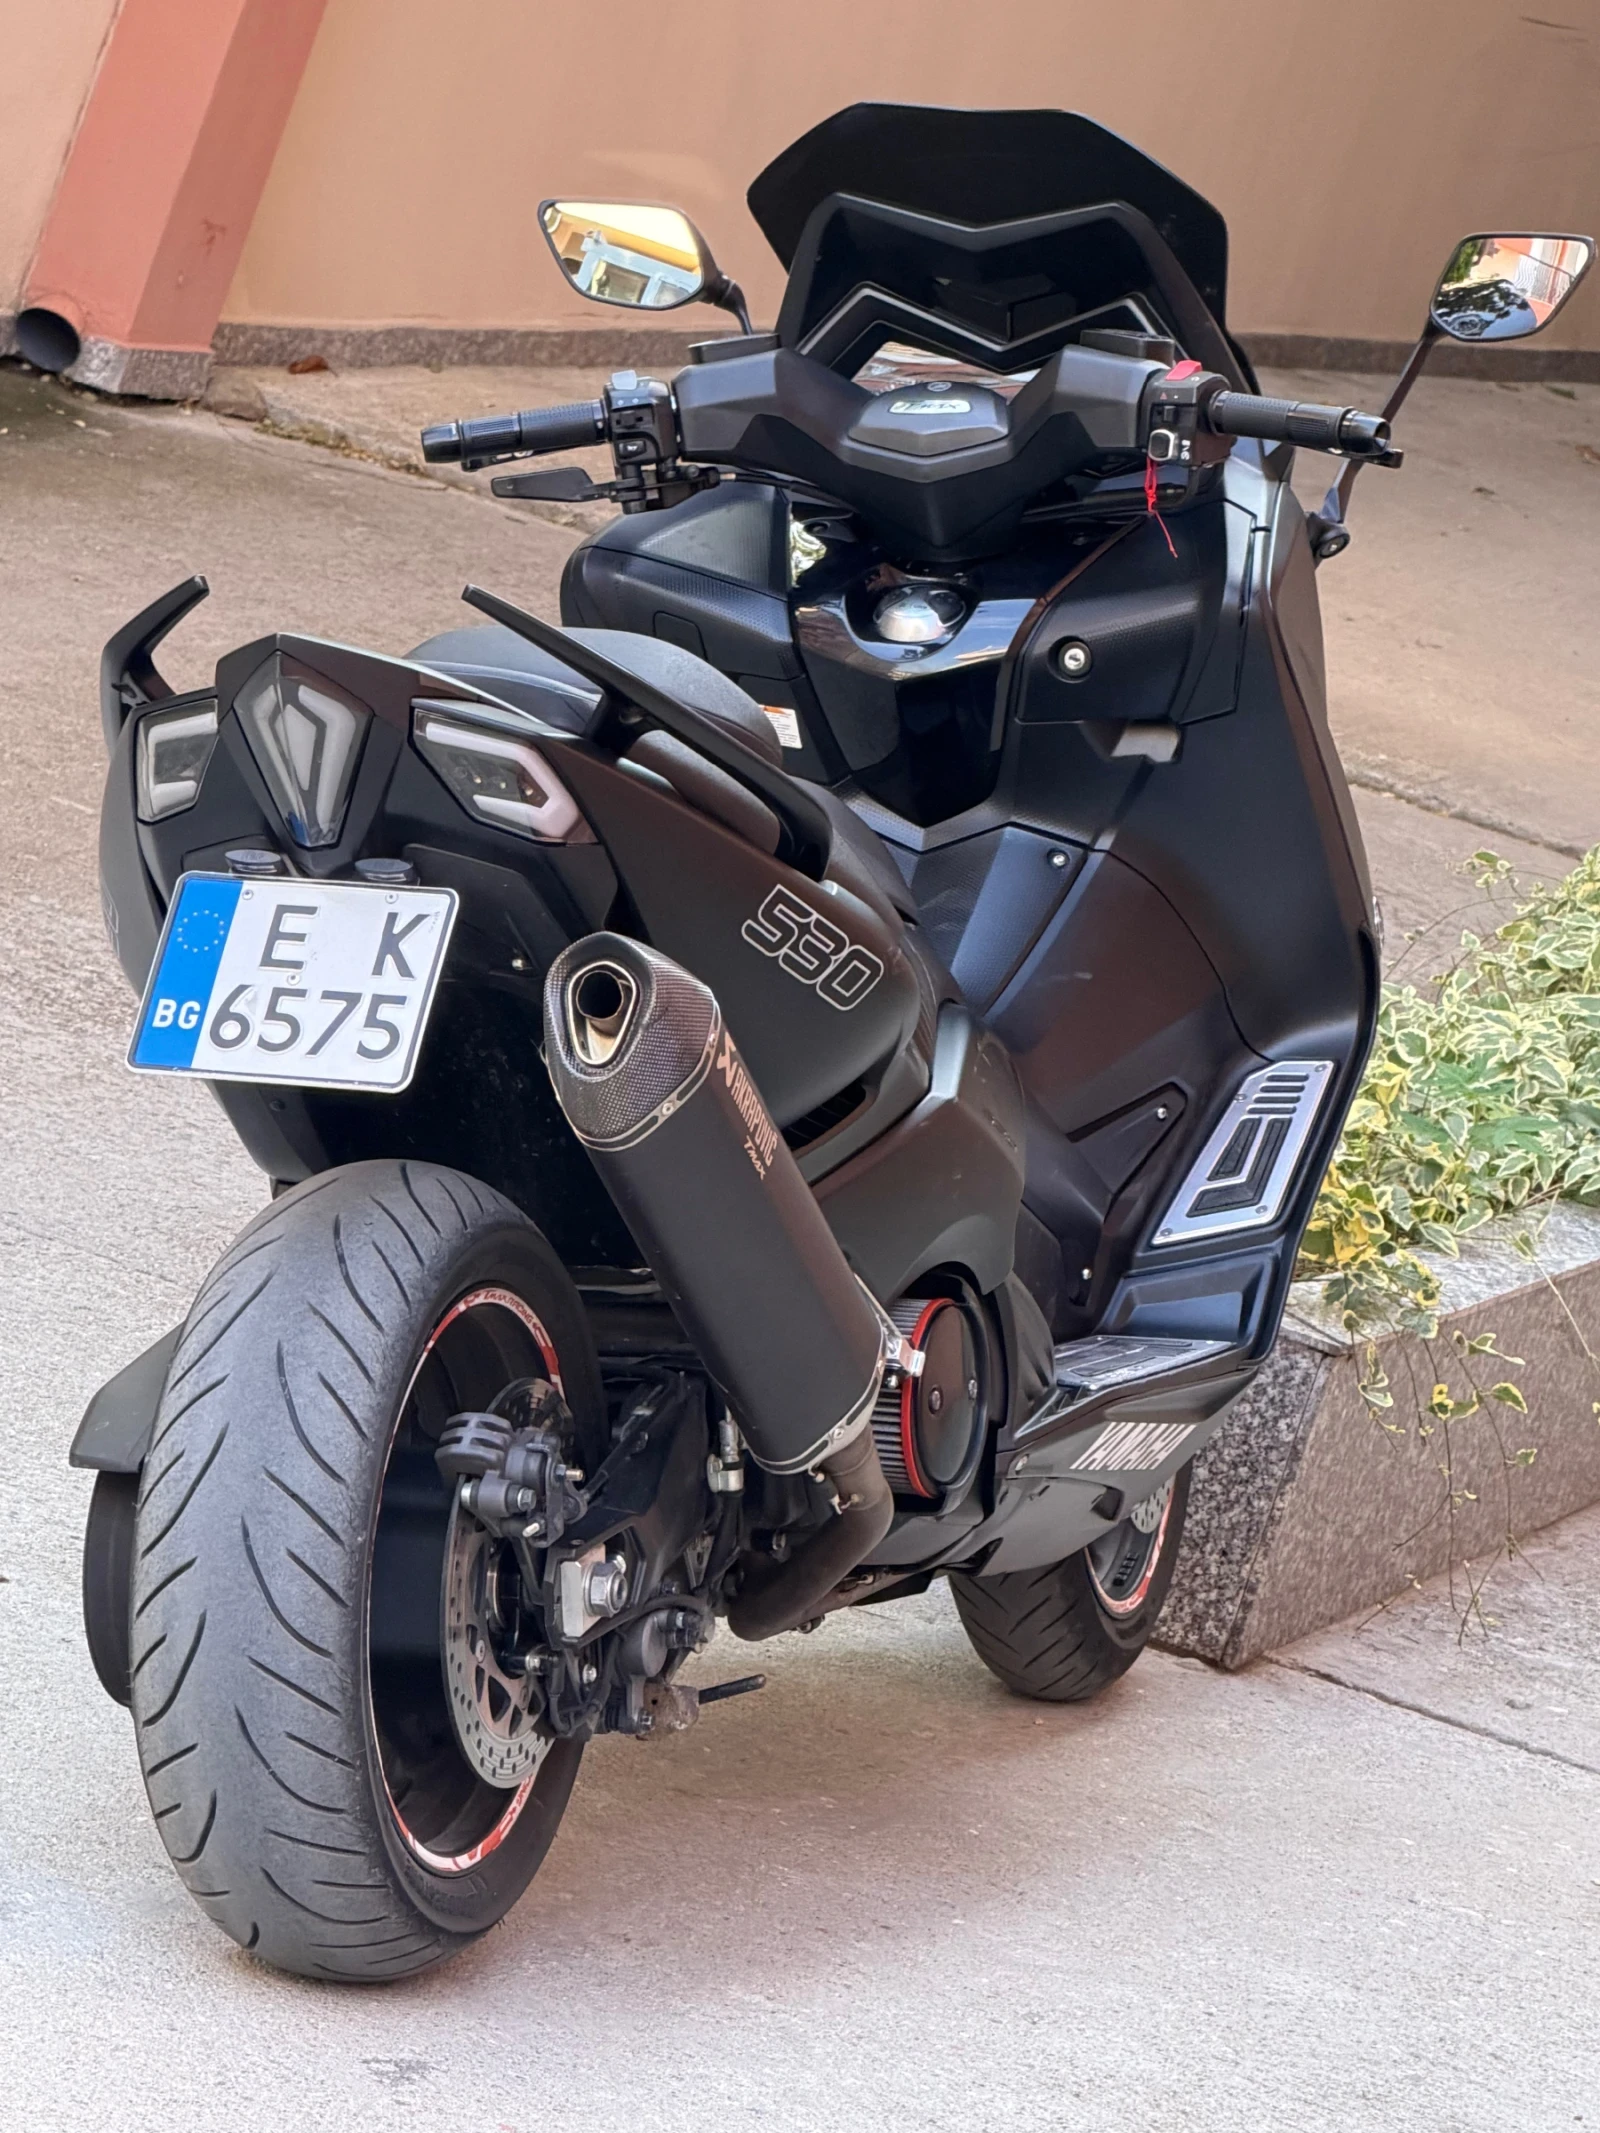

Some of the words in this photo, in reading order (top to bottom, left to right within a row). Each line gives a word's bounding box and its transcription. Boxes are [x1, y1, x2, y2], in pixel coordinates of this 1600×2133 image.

[259, 904, 318, 970] E
[371, 912, 431, 979] K
[741, 883, 884, 1011] 530
[152, 998, 201, 1030] BG
[209, 984, 408, 1060] 6575
[1069, 1421, 1197, 1471] YAMAHA
